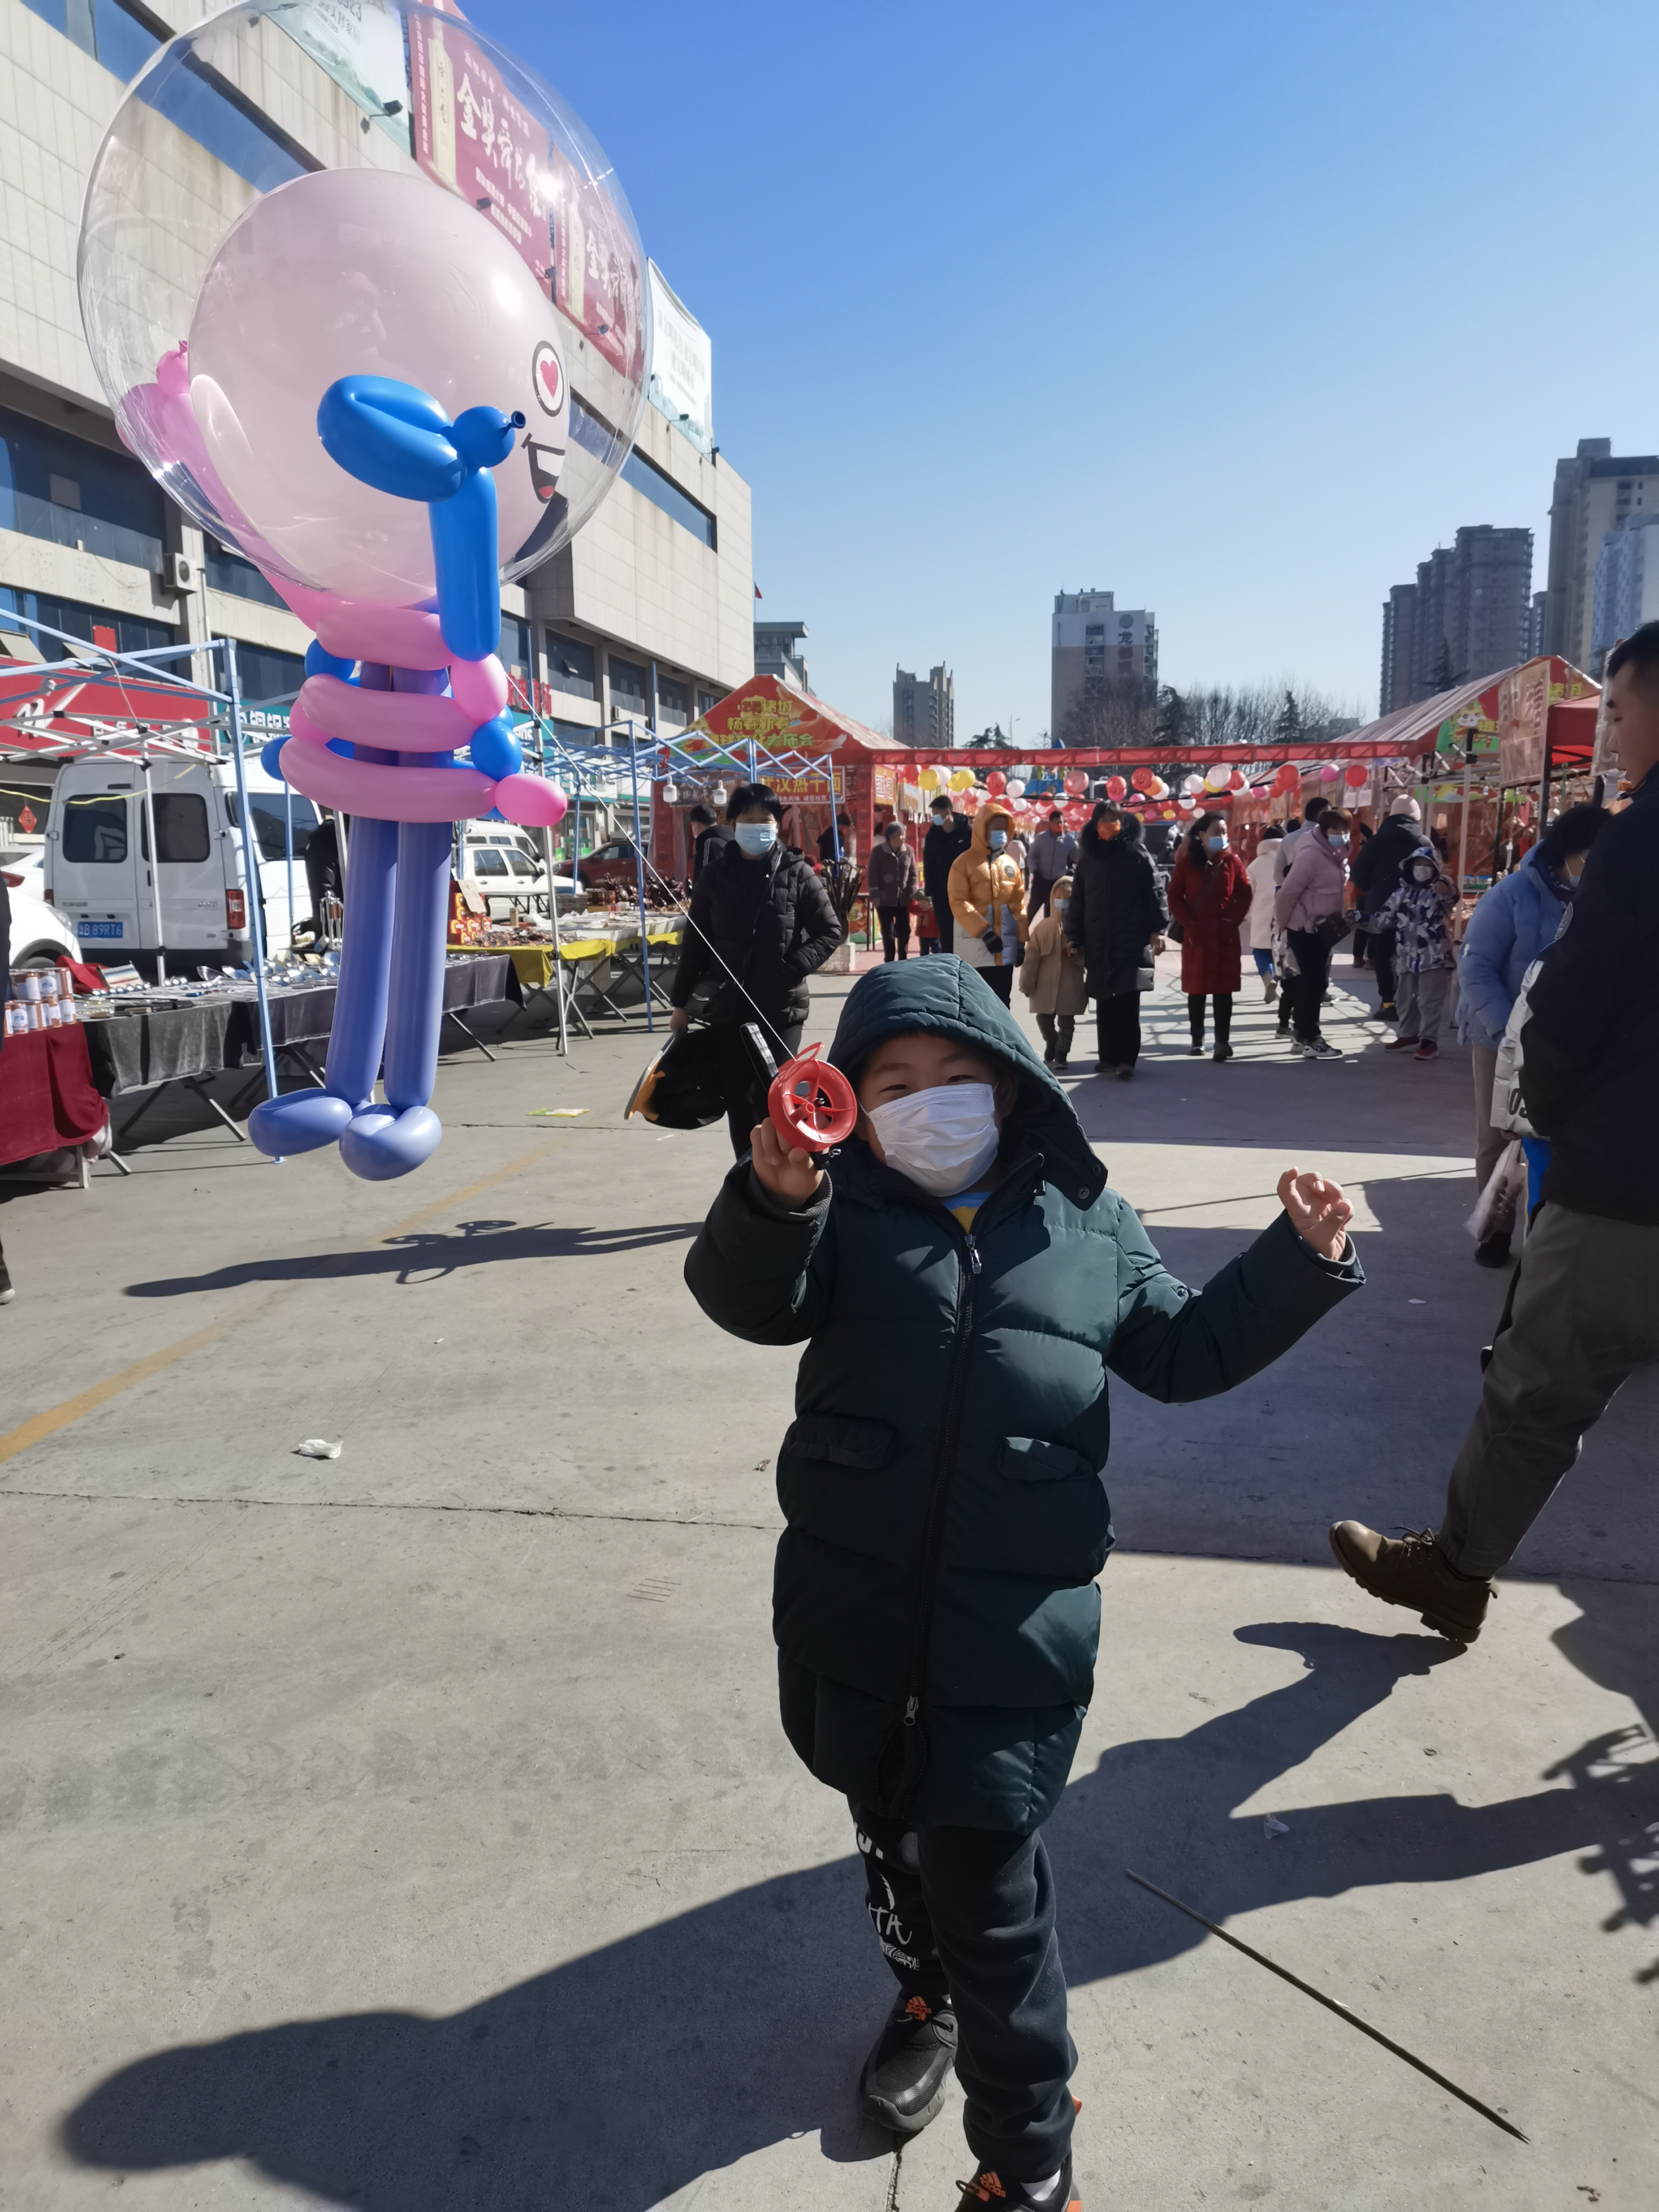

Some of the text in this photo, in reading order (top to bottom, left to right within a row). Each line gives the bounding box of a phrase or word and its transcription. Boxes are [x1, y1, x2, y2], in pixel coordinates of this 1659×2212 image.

[727, 717, 790, 731] 杨春新春
[979, 2176, 1006, 2198] adidas
